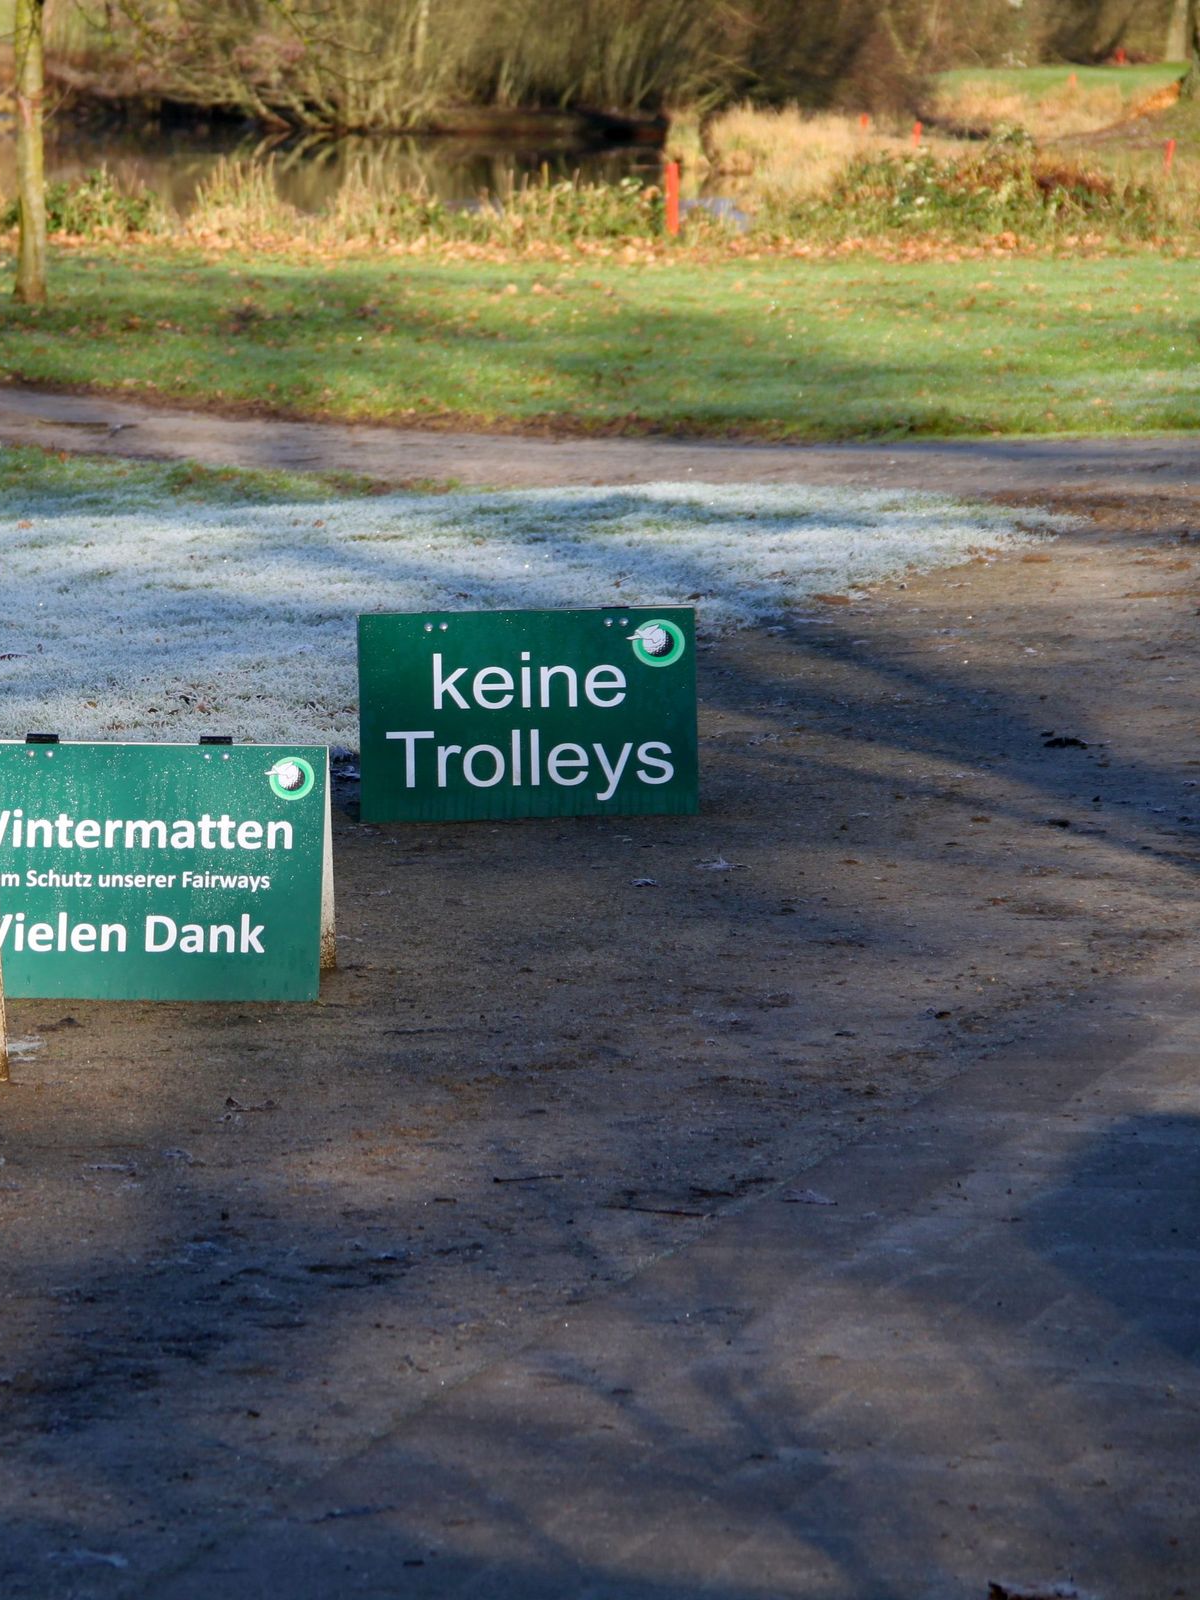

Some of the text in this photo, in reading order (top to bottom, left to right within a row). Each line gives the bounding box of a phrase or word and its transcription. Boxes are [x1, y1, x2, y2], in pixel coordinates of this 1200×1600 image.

[433, 652, 627, 709] keine
[385, 729, 675, 800] Trolleys
[26, 869, 92, 887] Schutz
[98, 873, 177, 888] unserer
[181, 871, 270, 892] Fairways
[145, 913, 266, 954] Dank
